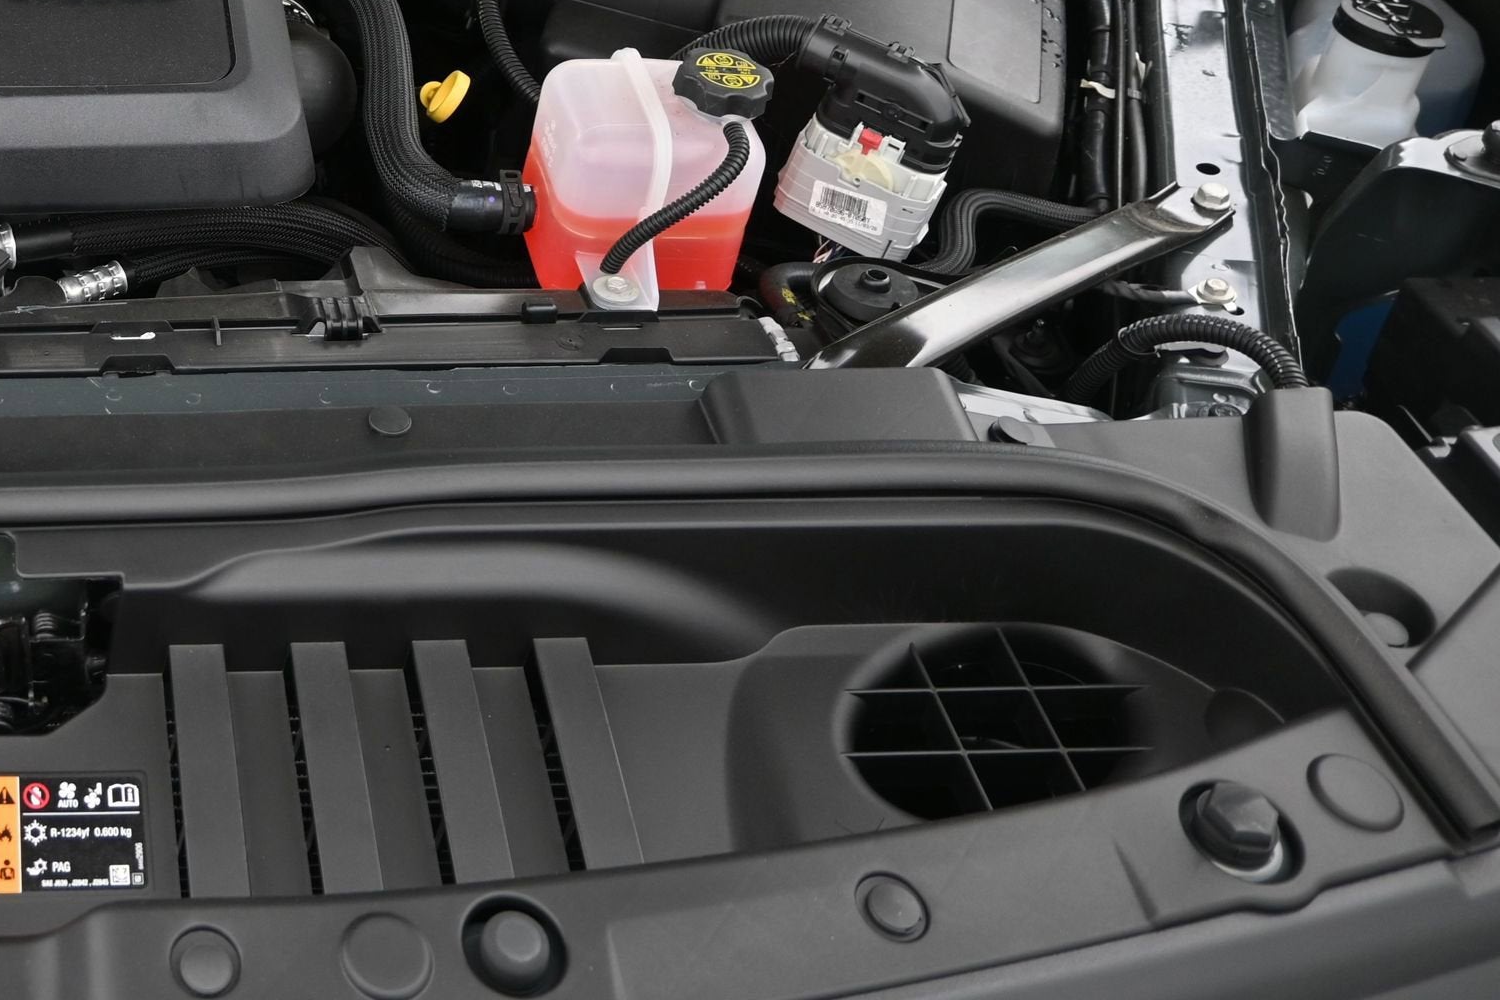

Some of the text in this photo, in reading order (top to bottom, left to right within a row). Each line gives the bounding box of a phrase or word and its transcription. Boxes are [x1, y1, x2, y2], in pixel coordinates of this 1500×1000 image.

[57, 799, 79, 808] AUTO
[50, 827, 90, 839] R-1234yf
[120, 826, 132, 838] kg
[52, 861, 71, 873] PAG
